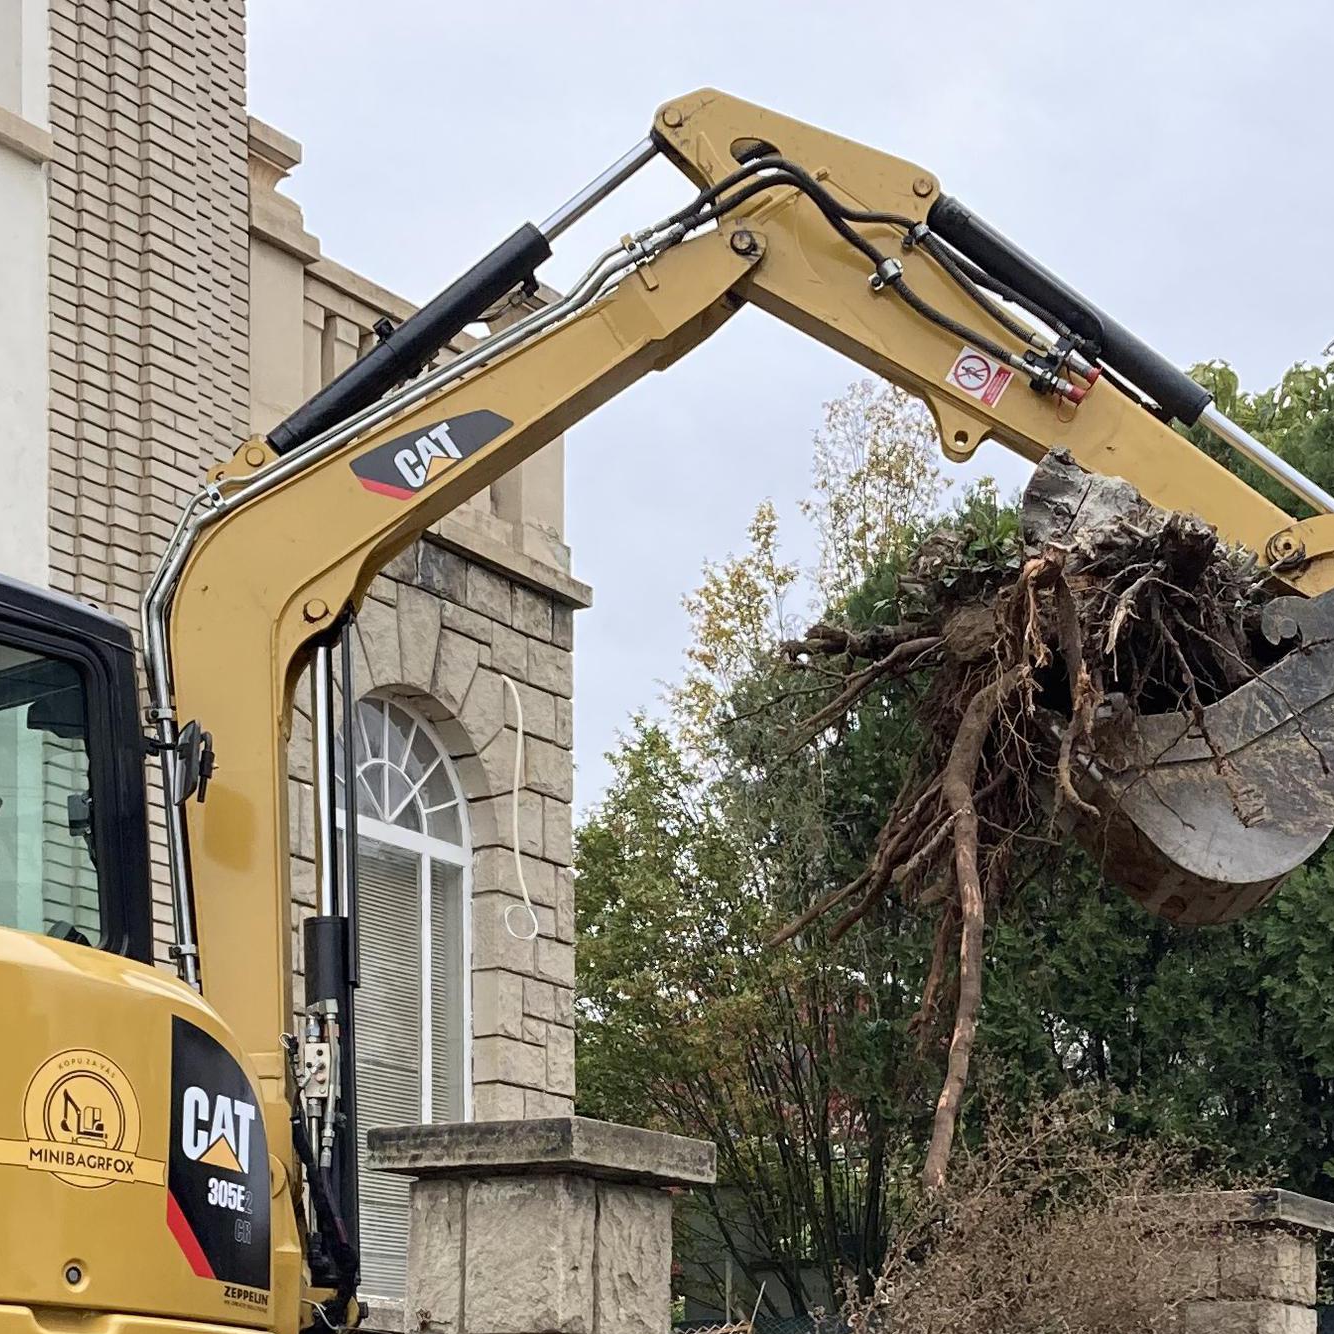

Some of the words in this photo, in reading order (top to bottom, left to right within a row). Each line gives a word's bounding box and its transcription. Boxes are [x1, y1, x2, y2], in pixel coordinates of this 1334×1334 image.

[393, 422, 463, 487] CAT
[182, 1086, 255, 1174] CAT
[29, 1147, 134, 1175] MINIBAGRFOX
[224, 1285, 269, 1306] ZEPPELIN
